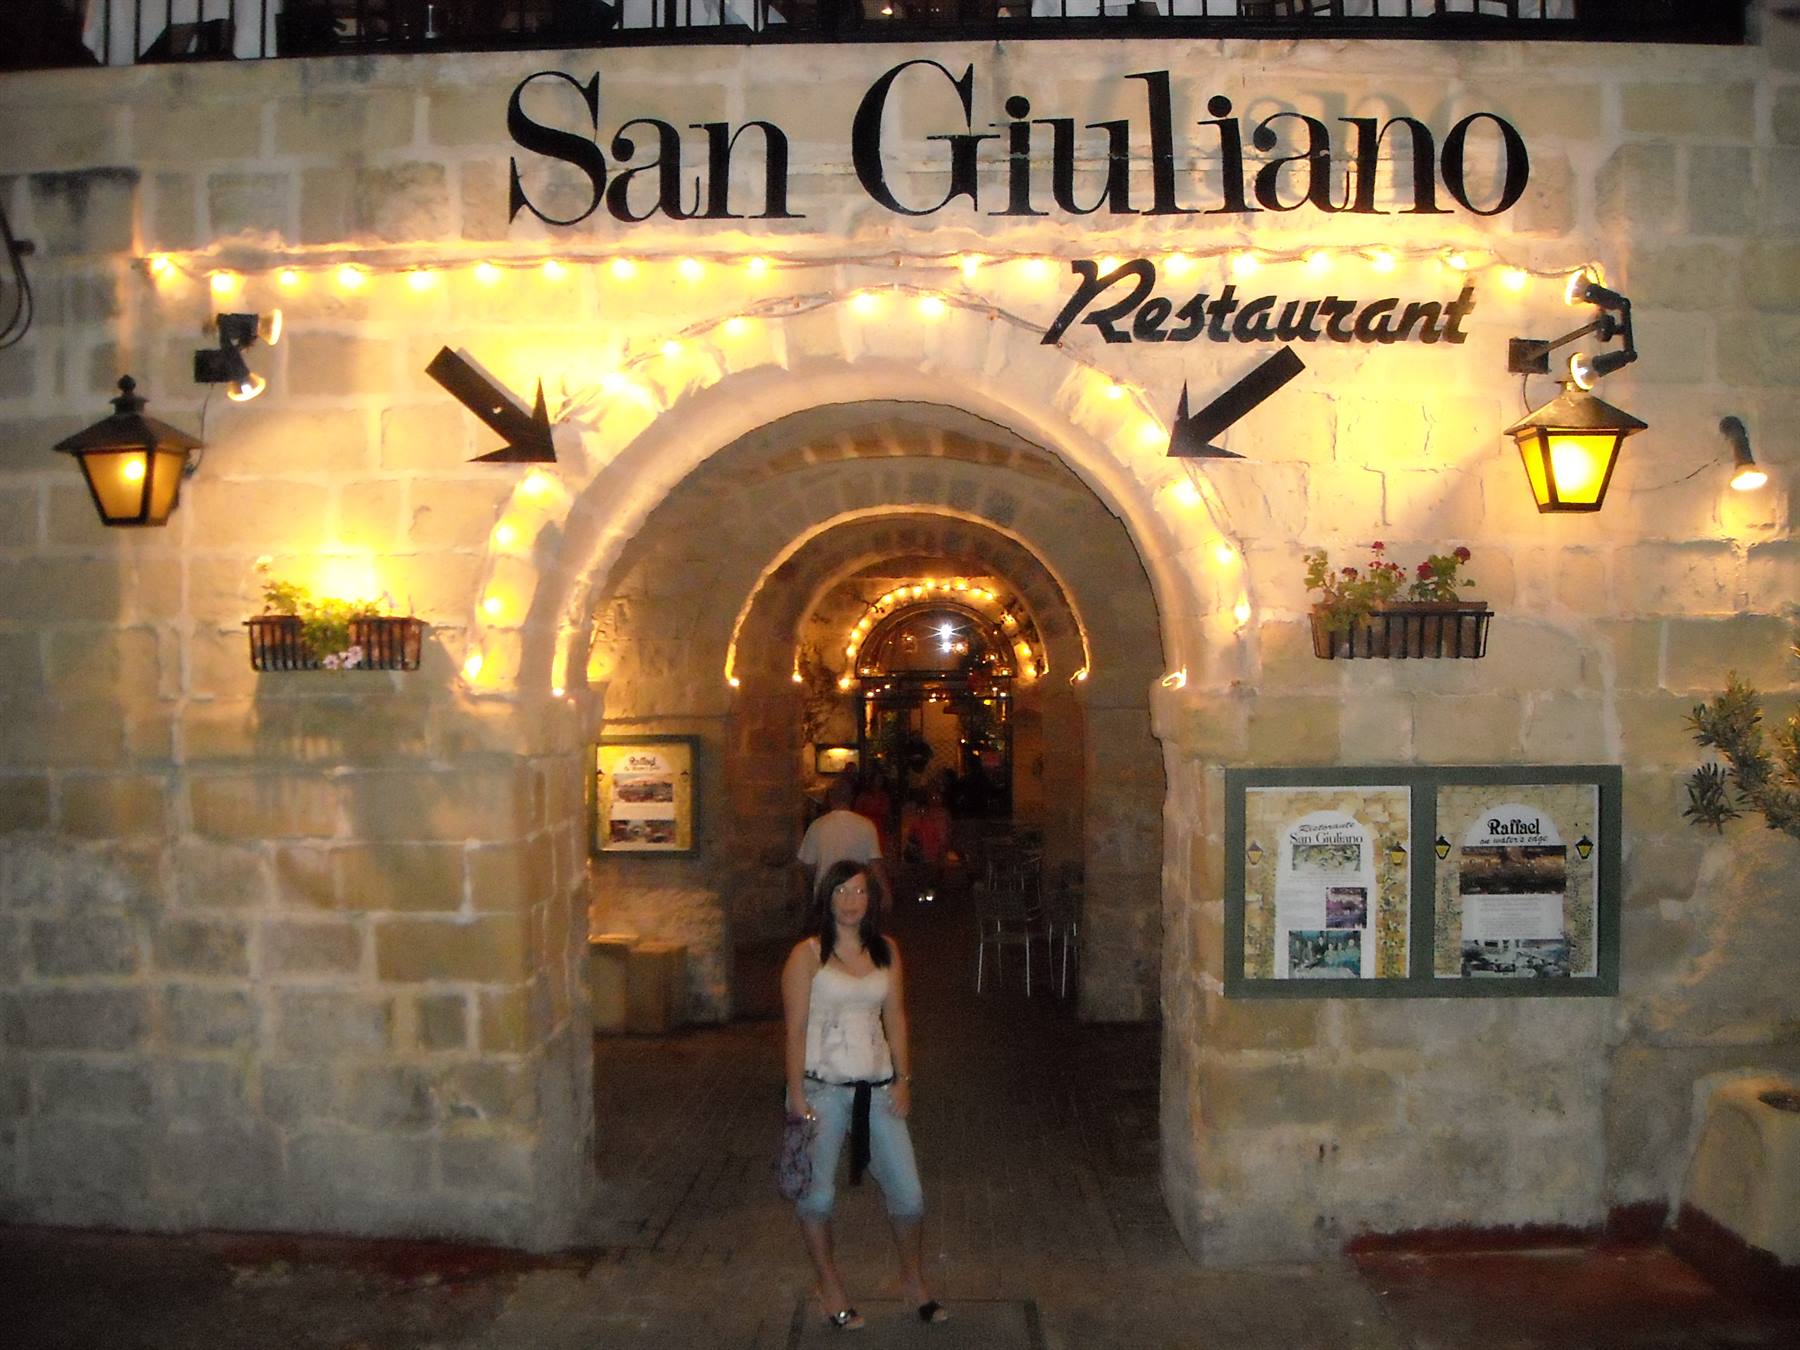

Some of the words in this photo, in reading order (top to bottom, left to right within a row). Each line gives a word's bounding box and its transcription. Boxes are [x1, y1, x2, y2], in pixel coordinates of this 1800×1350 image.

[507, 71, 805, 225] San
[852, 59, 1529, 217] Giuliano
[1041, 259, 1476, 345] Restaurant
[1290, 832, 1312, 844] San
[1316, 832, 1363, 844] Giuliano
[1488, 818, 1540, 835] Raffael
